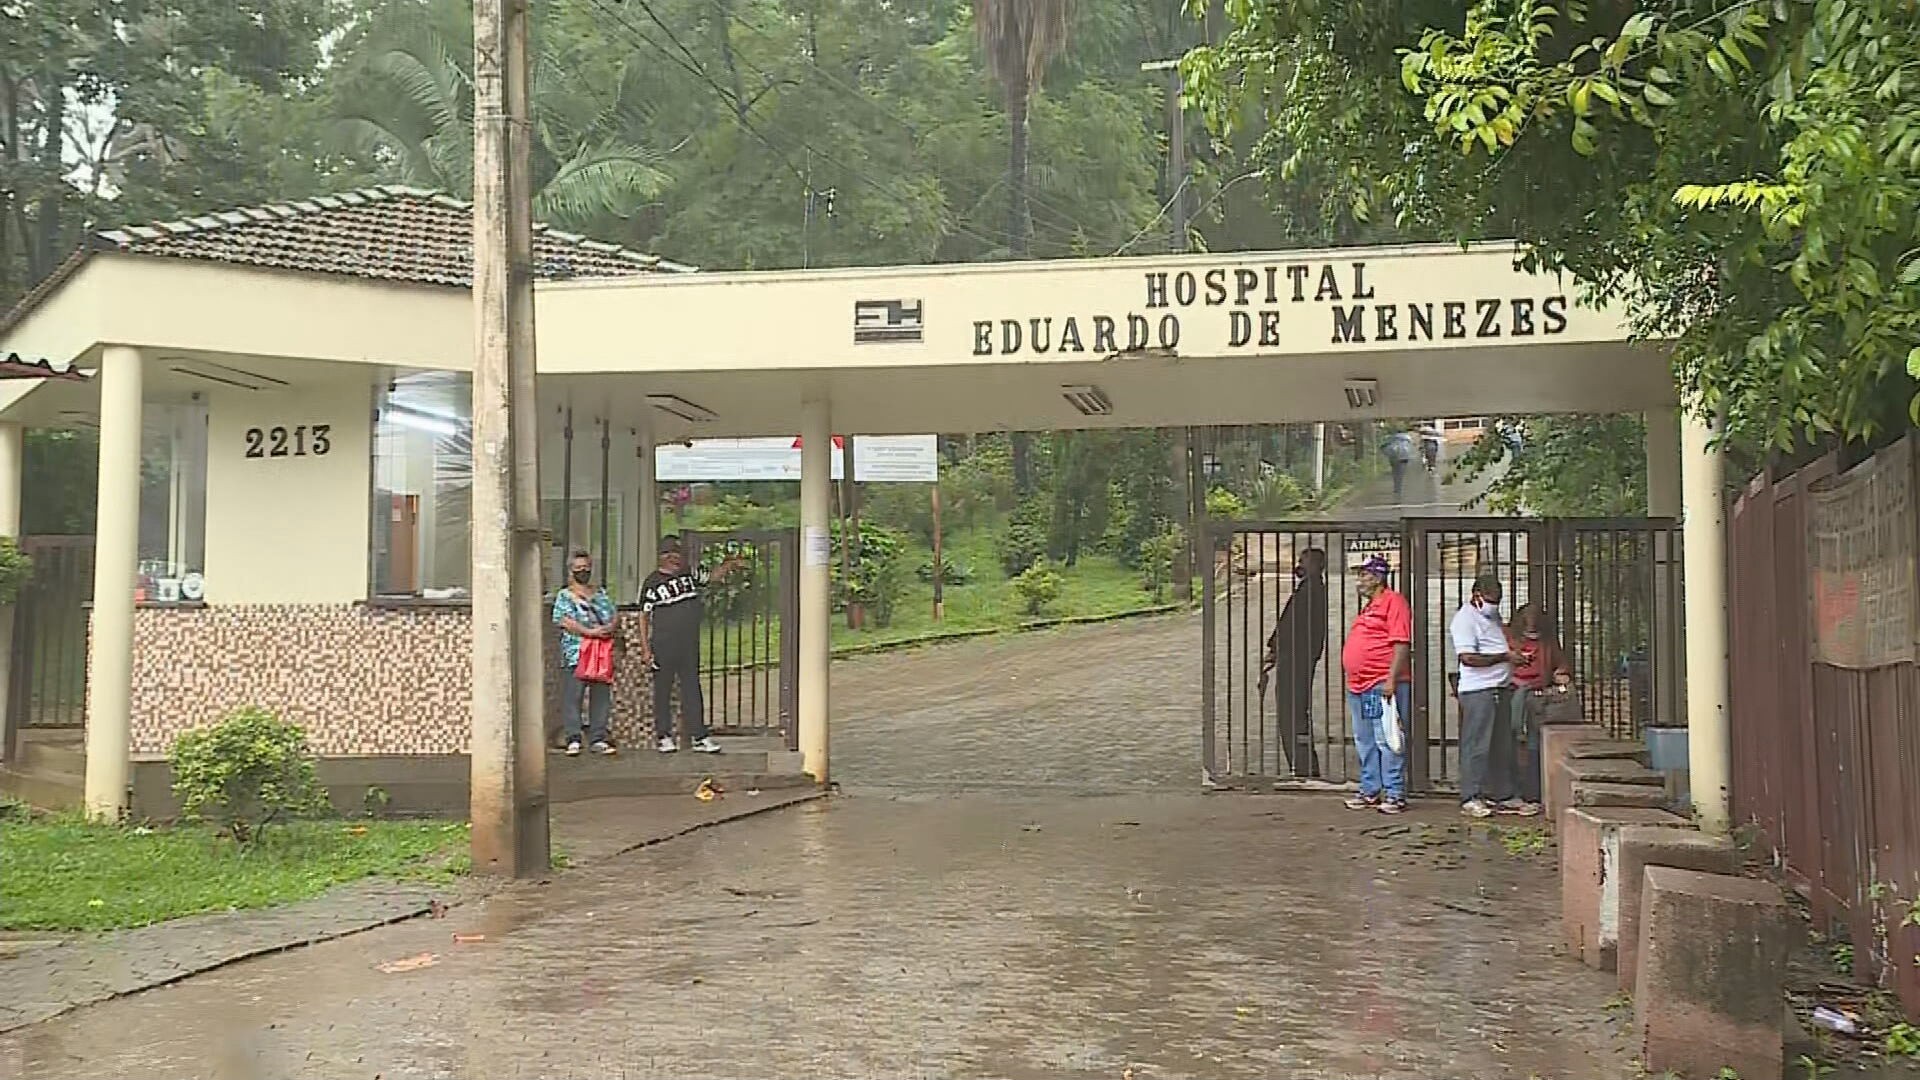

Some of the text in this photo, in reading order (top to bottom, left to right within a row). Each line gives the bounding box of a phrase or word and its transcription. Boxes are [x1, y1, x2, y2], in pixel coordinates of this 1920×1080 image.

[1145, 262, 1375, 308] HOSPITAL
[973, 295, 1568, 355] EDUARDO DE MENEZES
[245, 424, 331, 458] 2213
